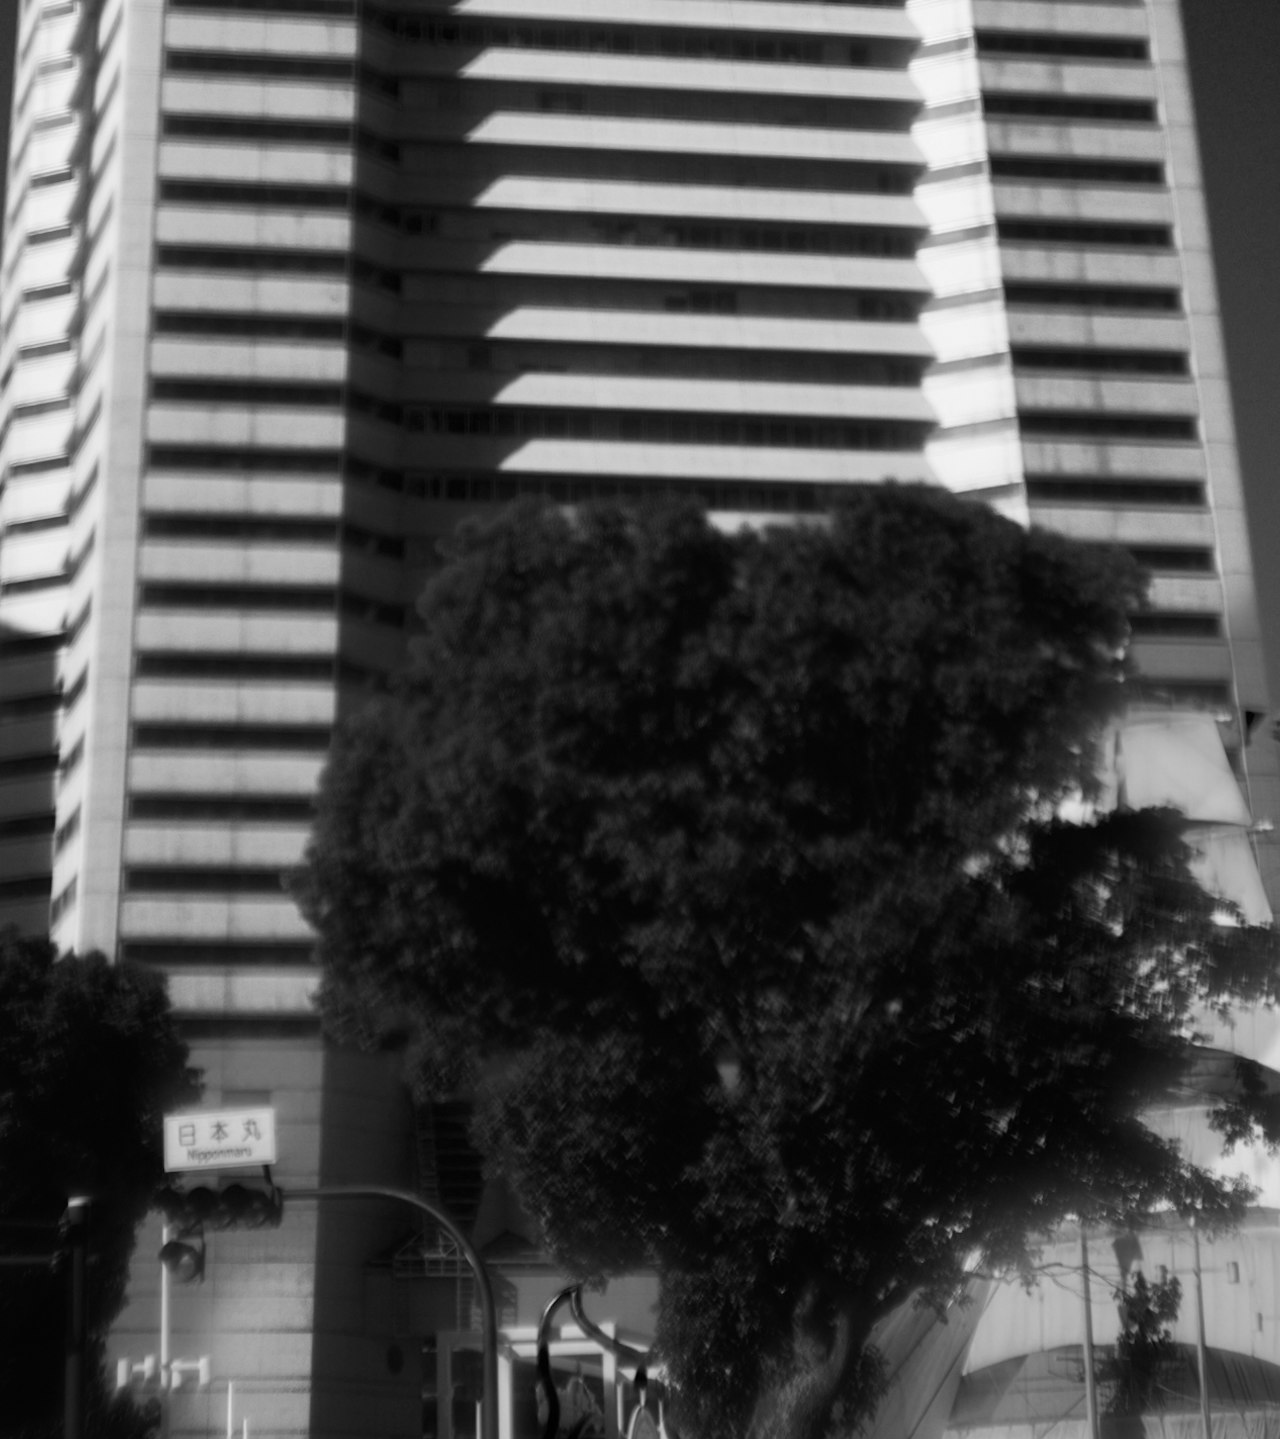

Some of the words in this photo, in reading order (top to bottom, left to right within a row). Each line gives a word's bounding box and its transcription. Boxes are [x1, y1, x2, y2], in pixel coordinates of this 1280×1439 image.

[179, 1120, 261, 1145] 日本丸
[187, 1147, 252, 1163] Nipponmaru
